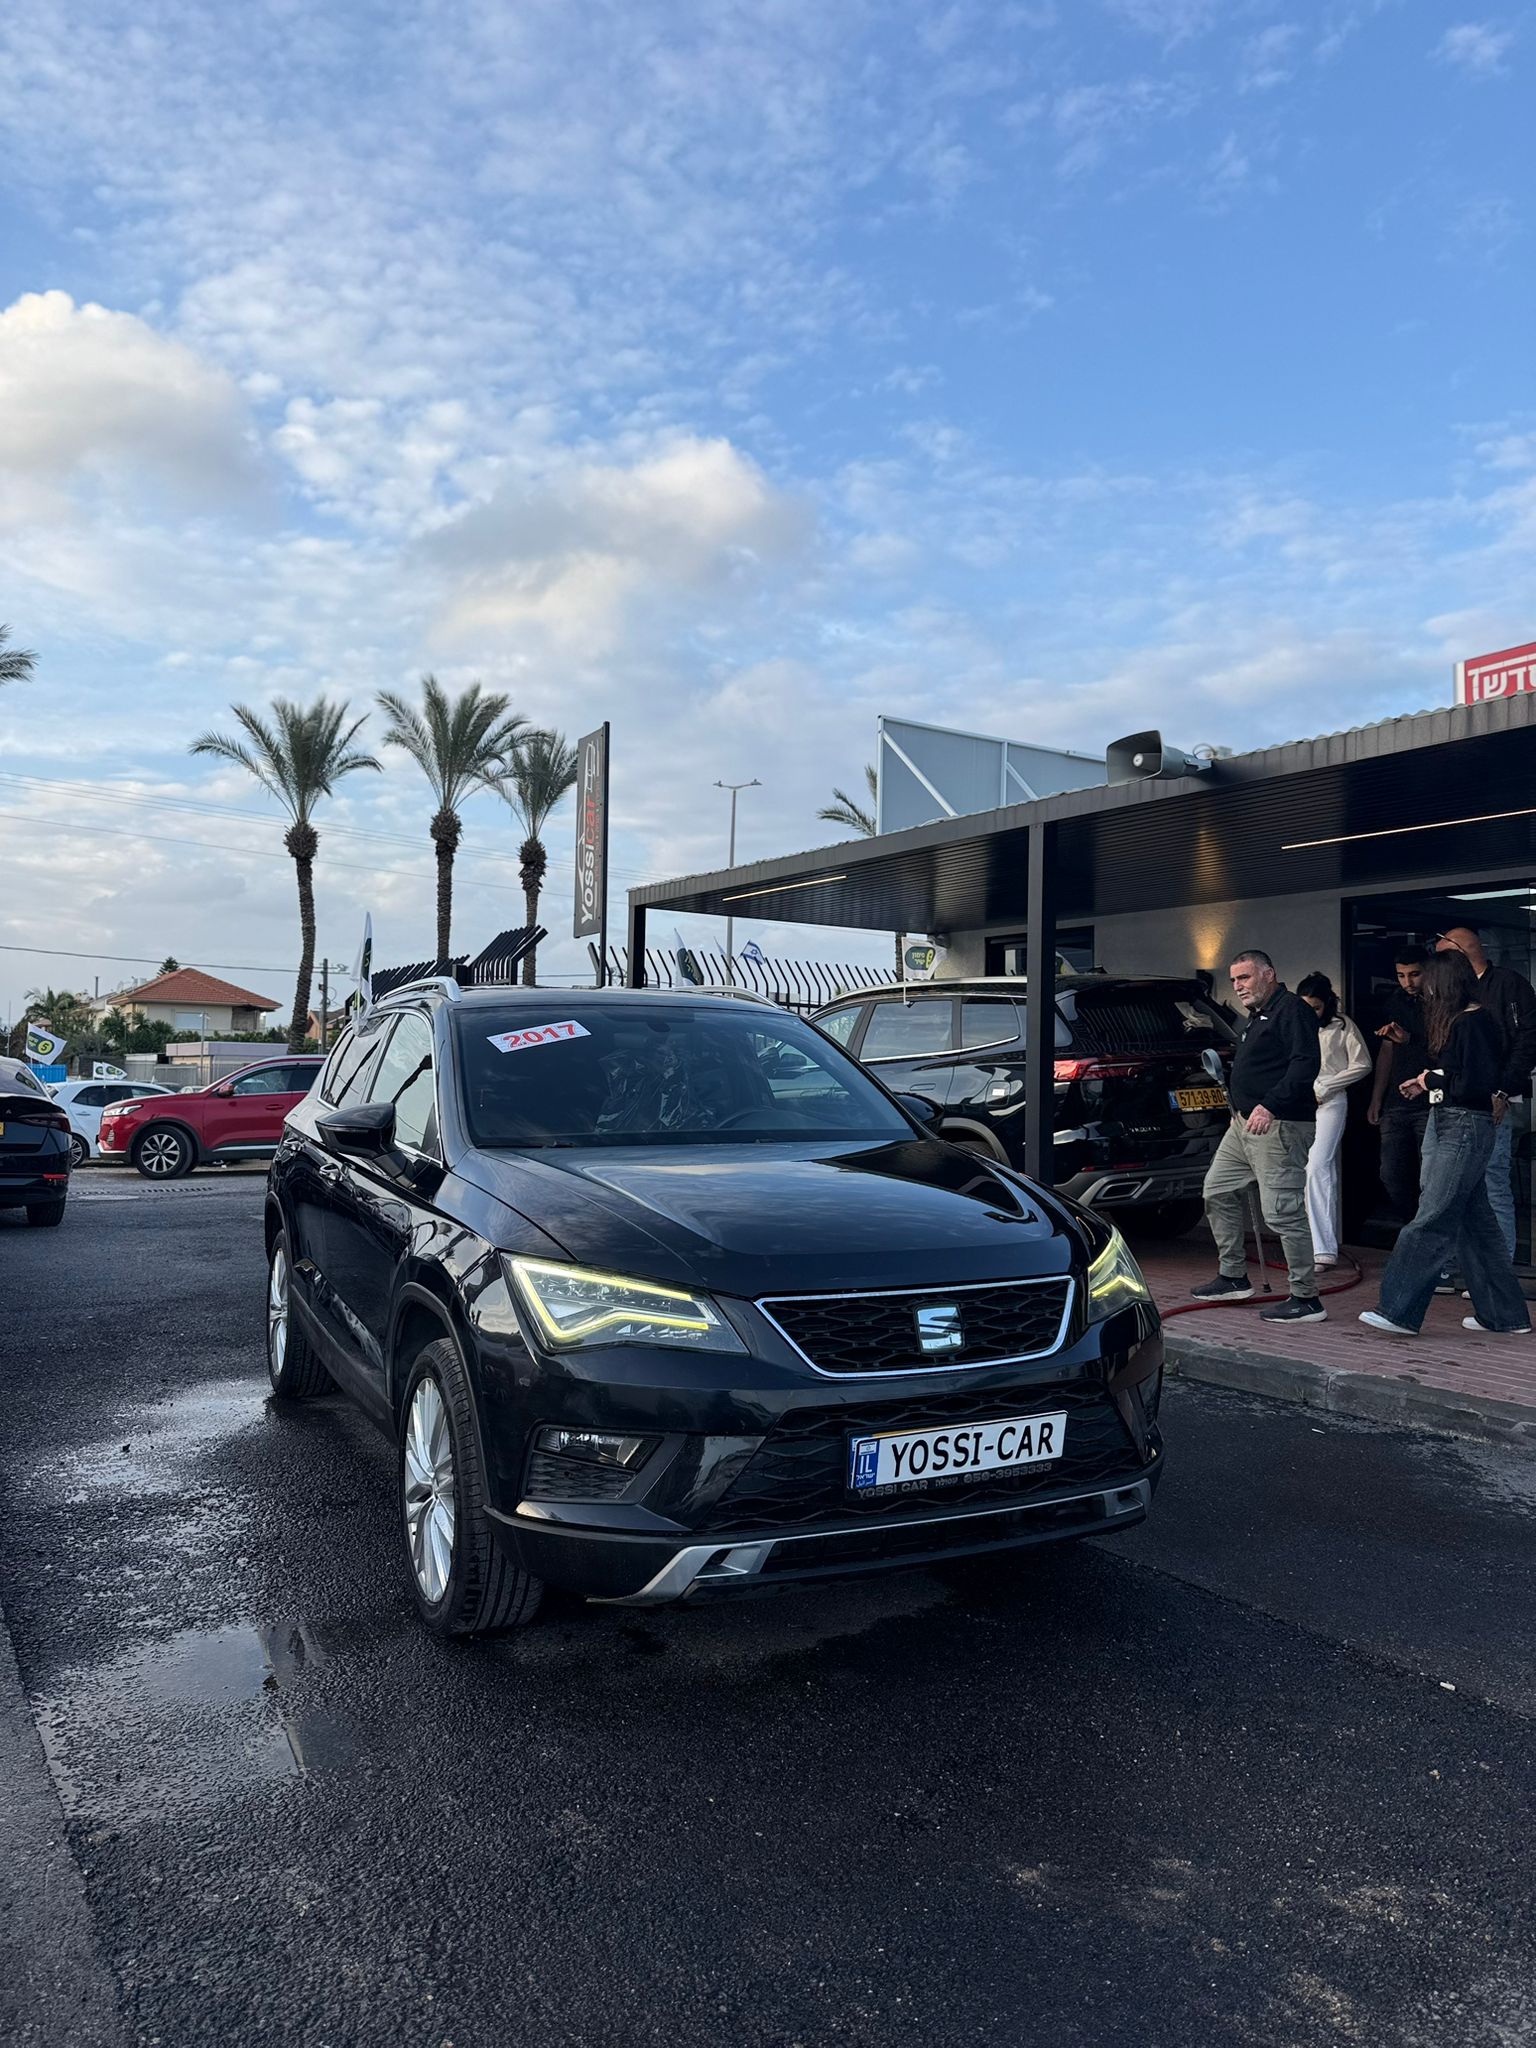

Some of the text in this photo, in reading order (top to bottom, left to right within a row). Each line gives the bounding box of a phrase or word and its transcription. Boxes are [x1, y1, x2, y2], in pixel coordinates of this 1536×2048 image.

[581, 796, 597, 925] Yossicar
[502, 1023, 575, 1049] 2017
[891, 1422, 1054, 1478] YOSSI-CAR
[860, 1455, 873, 1474] IL
[857, 1484, 897, 1499] YOSSI
[901, 1479, 928, 1492] CAR
